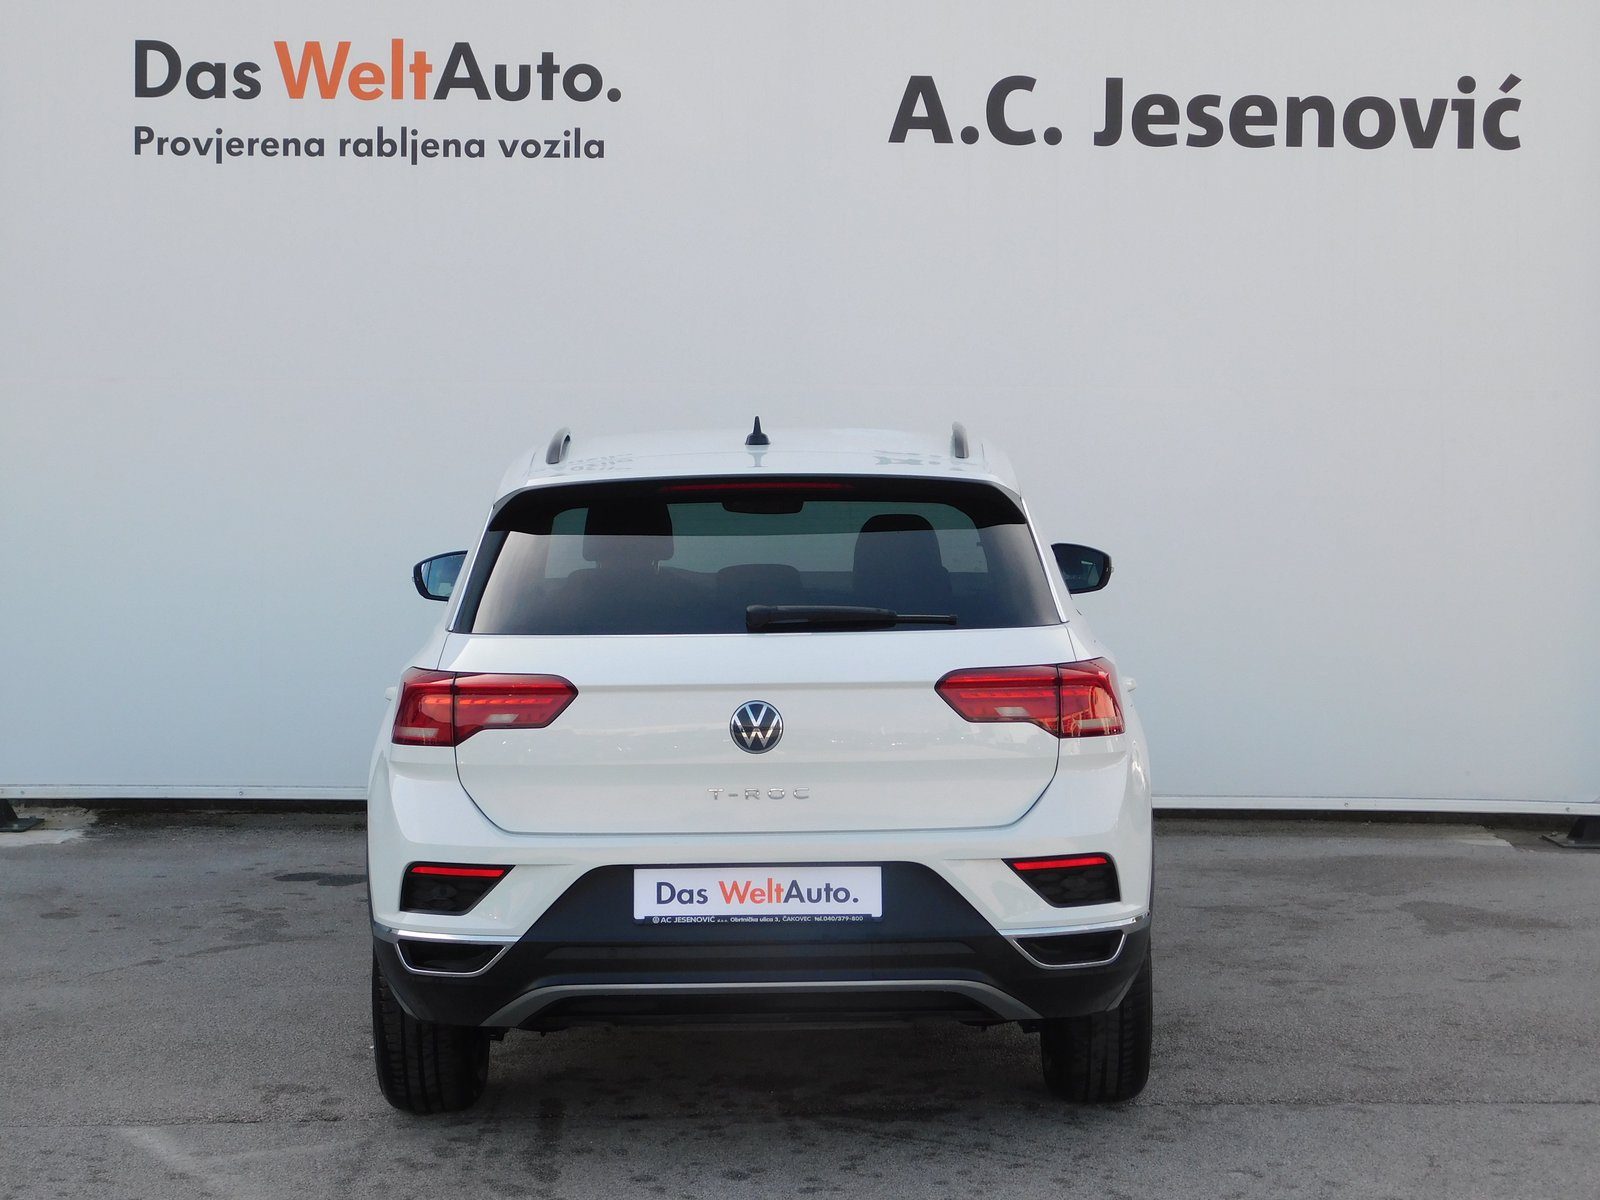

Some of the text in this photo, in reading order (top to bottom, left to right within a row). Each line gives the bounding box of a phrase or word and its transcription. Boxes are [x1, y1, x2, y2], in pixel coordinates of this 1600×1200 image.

[134, 38, 622, 103] Das WeltAuto.
[887, 73, 1522, 151] A.C. Jesenović
[134, 125, 605, 166] Provjerena rabljena vozila
[707, 787, 811, 800] T-ROC
[656, 877, 859, 905] Das WeltAuto.
[673, 915, 716, 923] JESENOVIĆ
